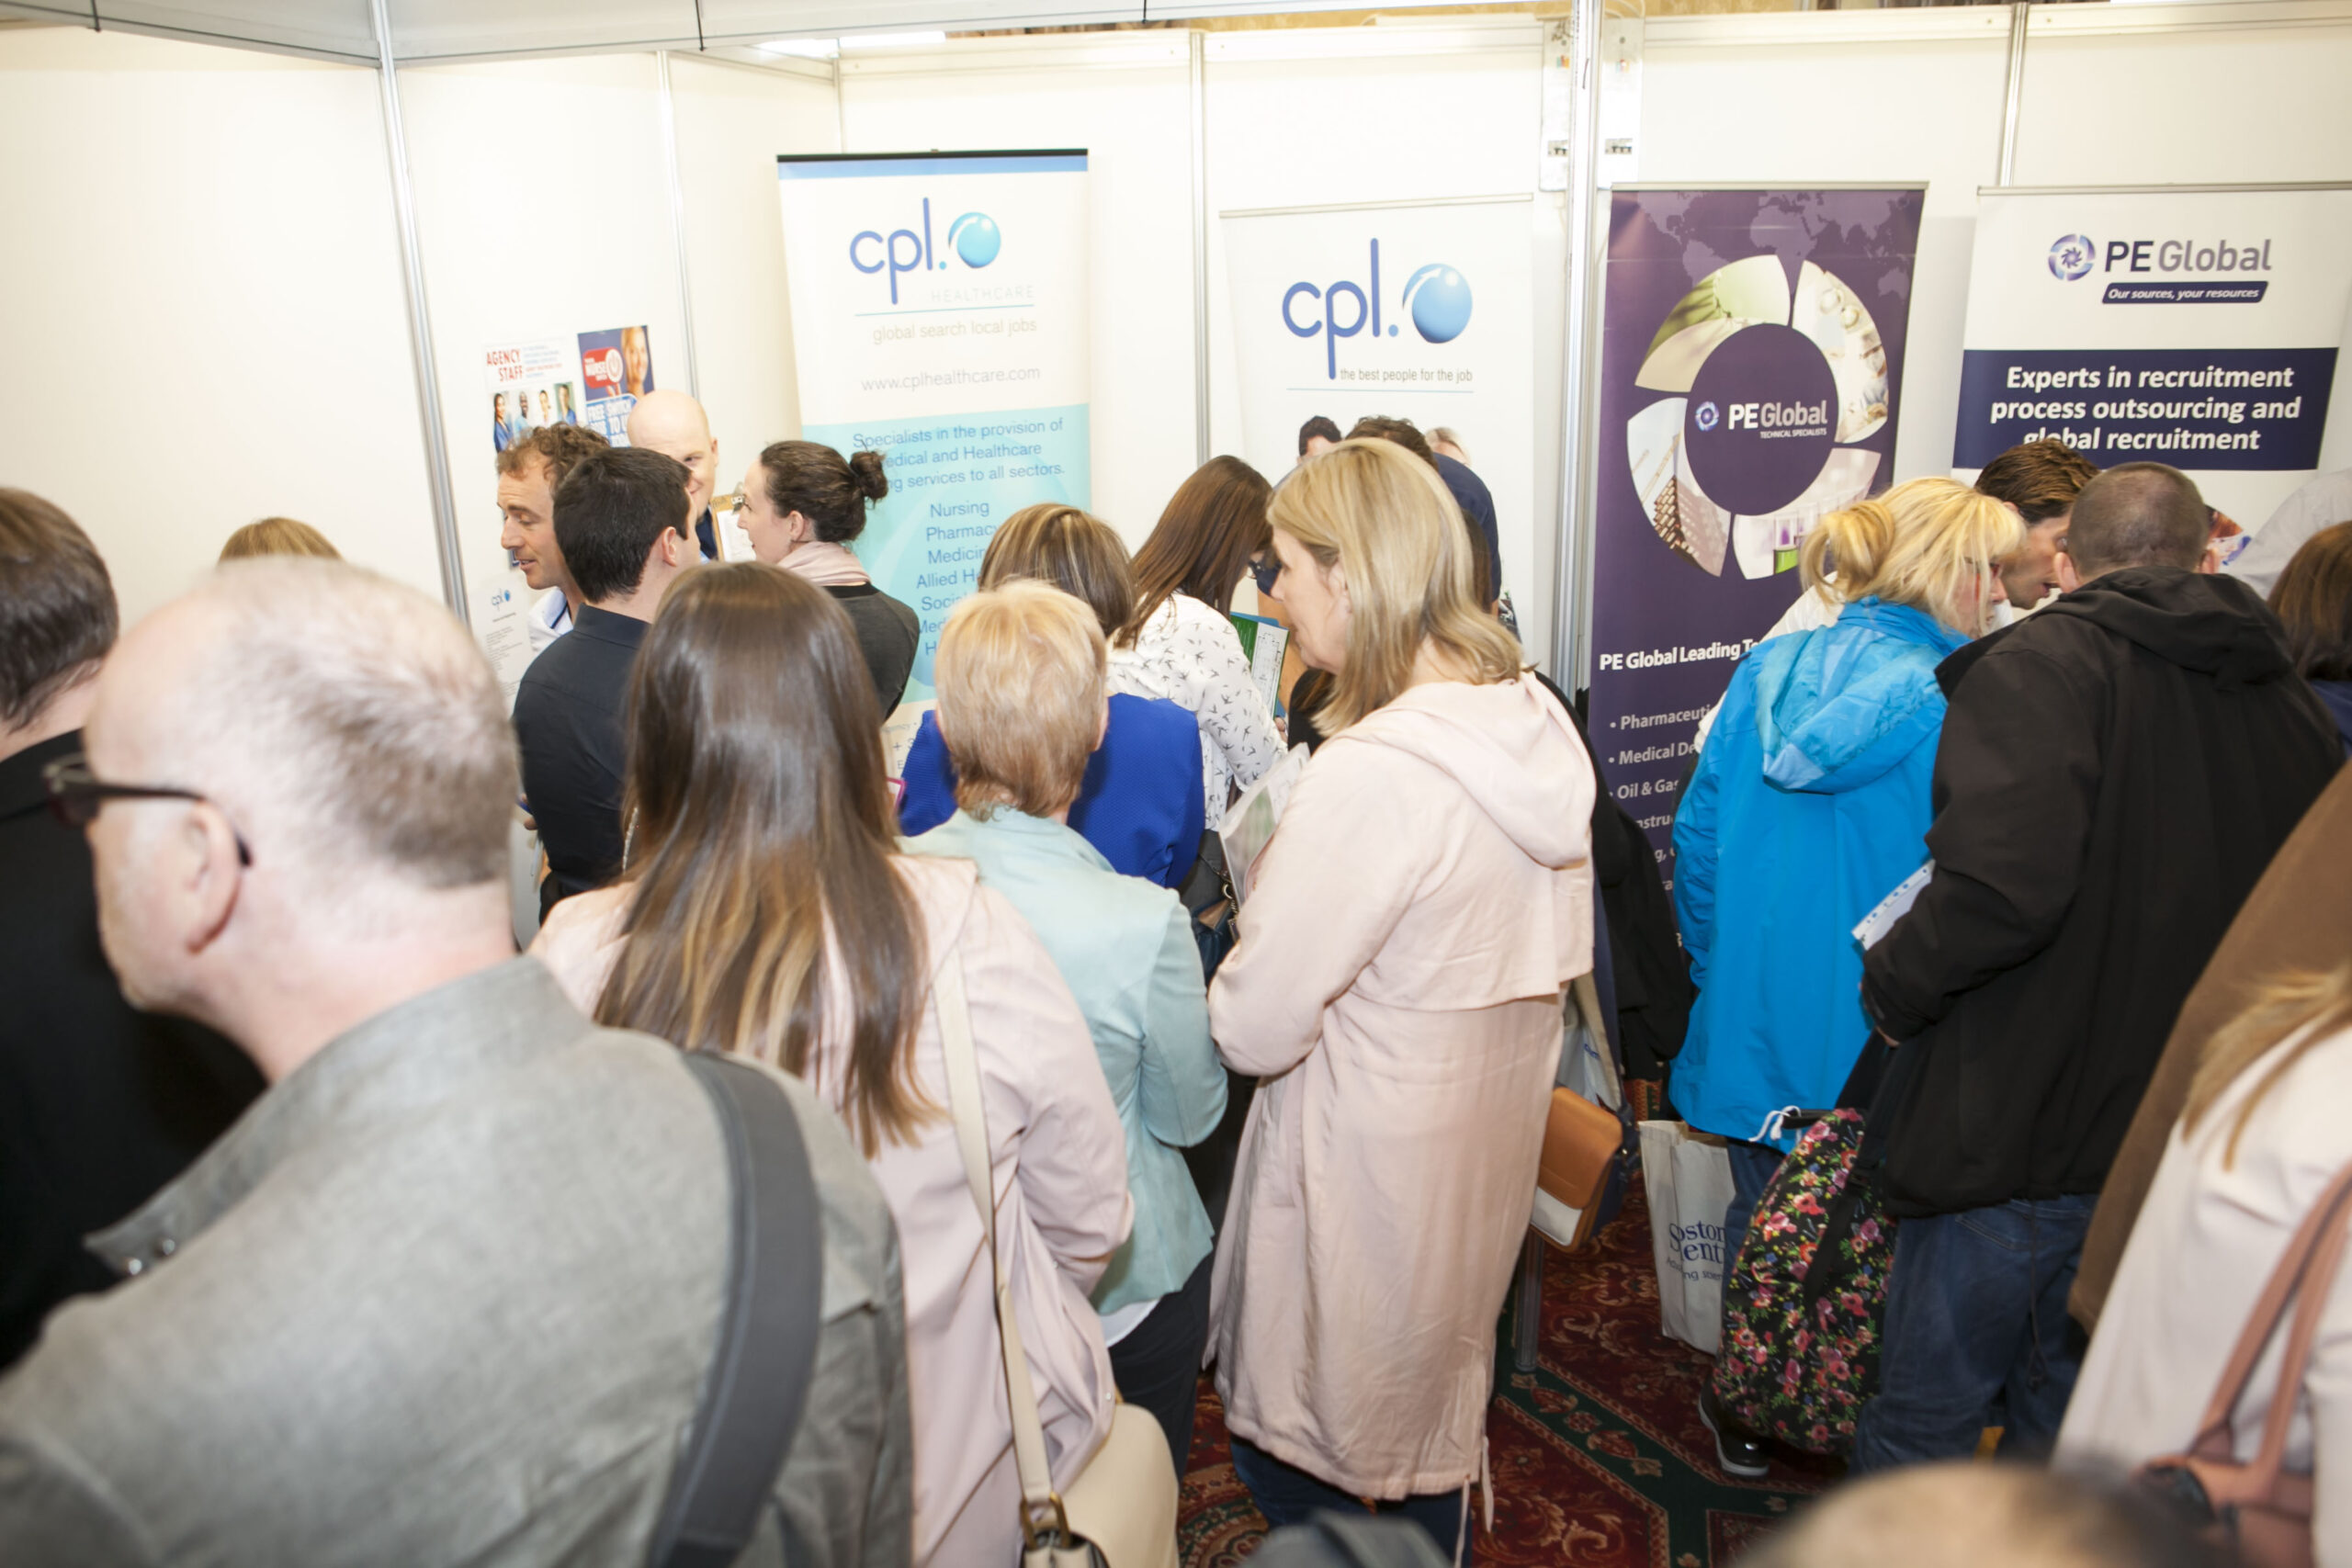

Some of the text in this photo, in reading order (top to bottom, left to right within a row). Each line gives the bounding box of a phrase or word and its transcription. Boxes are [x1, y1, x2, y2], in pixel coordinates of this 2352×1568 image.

[931, 285, 1035, 303] HEALTHCARE
[2108, 287, 2259, 301] Our sources, your resources
[873, 318, 1037, 344] global search local jobs
[486, 348, 520, 366] AGENCY
[498, 365, 523, 382] STAFF
[861, 367, 1041, 392] www.cplhealthcare.com
[1340, 367, 1473, 384] the best people for the job
[2007, 366, 2294, 393] Experts in recruitment
[1990, 396, 2302, 424] process outsourcing and
[853, 418, 1064, 448] Specialists in the provision of
[2107, 427, 2260, 450] recruitment
[885, 443, 1042, 468] edical and Healthcare
[907, 473, 966, 489] services
[970, 469, 984, 481] to
[989, 467, 1005, 480] all
[1009, 463, 1066, 479] sectors.
[930, 501, 989, 518] Nursing
[926, 525, 997, 541] Pharmac
[916, 570, 957, 589] Allied
[1600, 653, 1623, 670] PE
[1625, 647, 1678, 669] Global
[1679, 641, 1741, 663] Leading
[1621, 704, 1711, 730] Pharmaceuti
[1618, 742, 1675, 765] Medical
[1617, 780, 1639, 799] Oil
[1641, 780, 1653, 795] &
